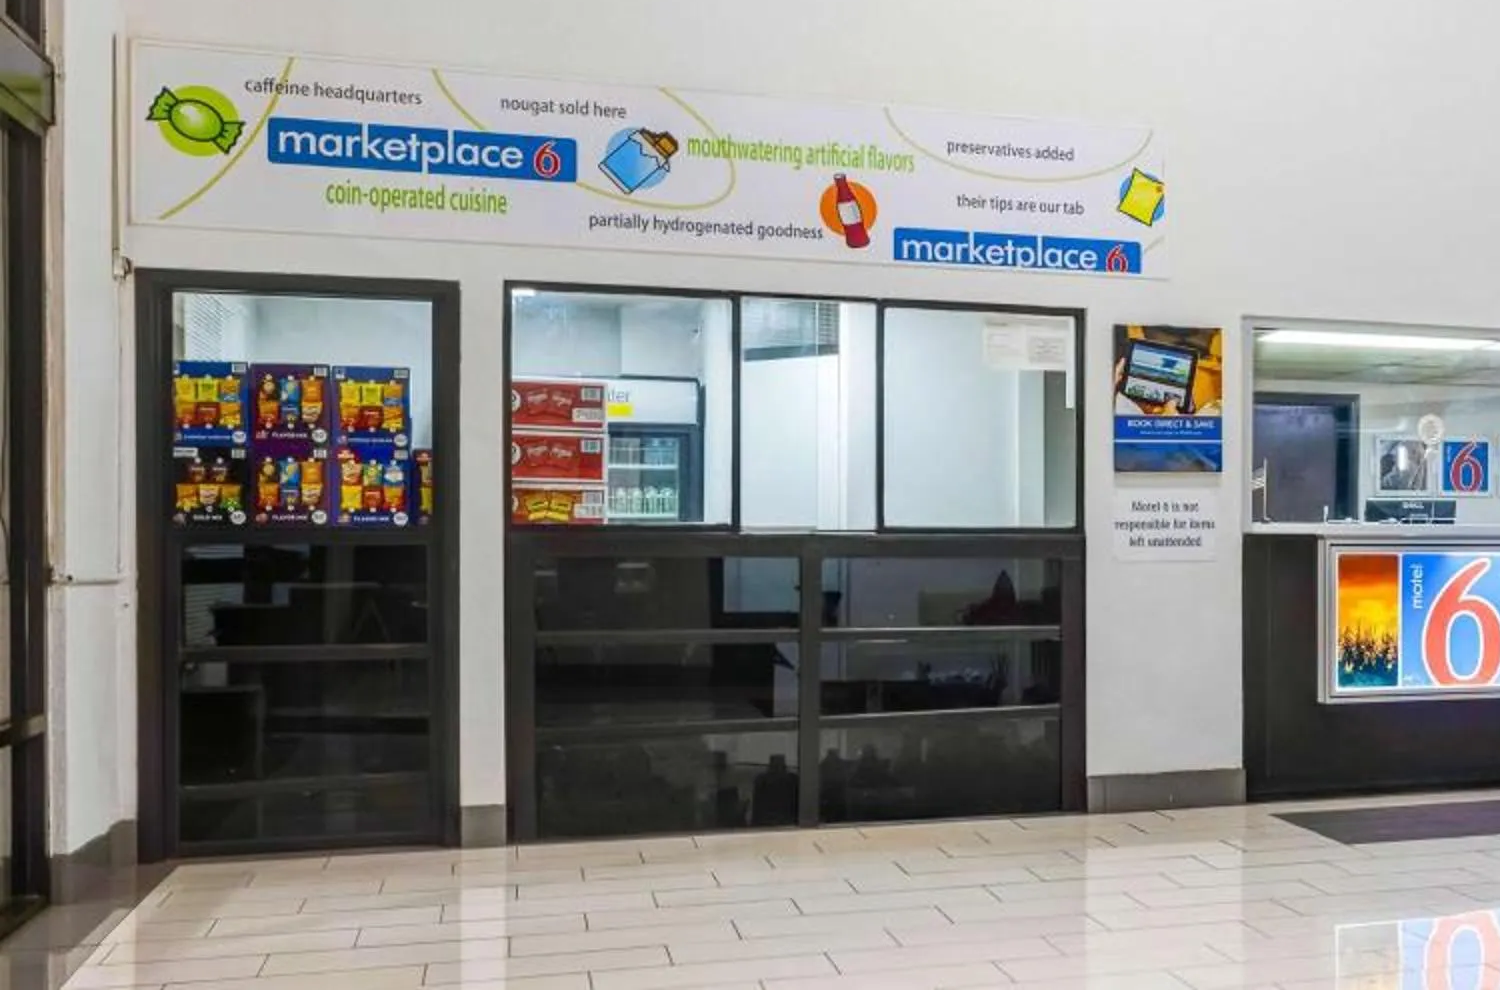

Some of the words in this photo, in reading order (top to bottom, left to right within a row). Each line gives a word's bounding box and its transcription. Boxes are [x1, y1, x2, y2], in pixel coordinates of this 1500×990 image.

[244, 78, 310, 97] caffeine
[313, 83, 423, 106] headquarters
[500, 97, 555, 116] nougat
[559, 100, 589, 115] sold
[593, 101, 627, 119] here
[278, 124, 524, 175] marketplace
[533, 139, 562, 179] 6
[687, 134, 801, 170] mouthwatering
[805, 141, 865, 168] artificial
[868, 144, 915, 173] flavors
[946, 141, 1032, 159] preservatives
[1035, 145, 1075, 161] added
[325, 181, 445, 213] coin-operated
[450, 189, 507, 214] cuisine
[957, 194, 986, 210] their
[989, 196, 1013, 213] tips
[1016, 201, 1037, 213] are
[1039, 203, 1062, 214] our
[1063, 202, 1085, 215] tab
[589, 213, 649, 233] partially
[653, 215, 753, 237] hydrogenated
[757, 223, 823, 241] goodness
[901, 230, 1098, 270] marketplace
[1105, 242, 1129, 273] 6
[1127, 419, 1152, 428] BOOK
[1131, 501, 1161, 512] Motel
[1171, 502, 1181, 512] is
[1183, 502, 1199, 512] not
[1114, 519, 1171, 531] responsible
[1173, 518, 1187, 529] for
[1189, 519, 1216, 529] items
[1129, 536, 1145, 547] left
[1147, 536, 1202, 547] unattended
[1409, 563, 1424, 610] motel
